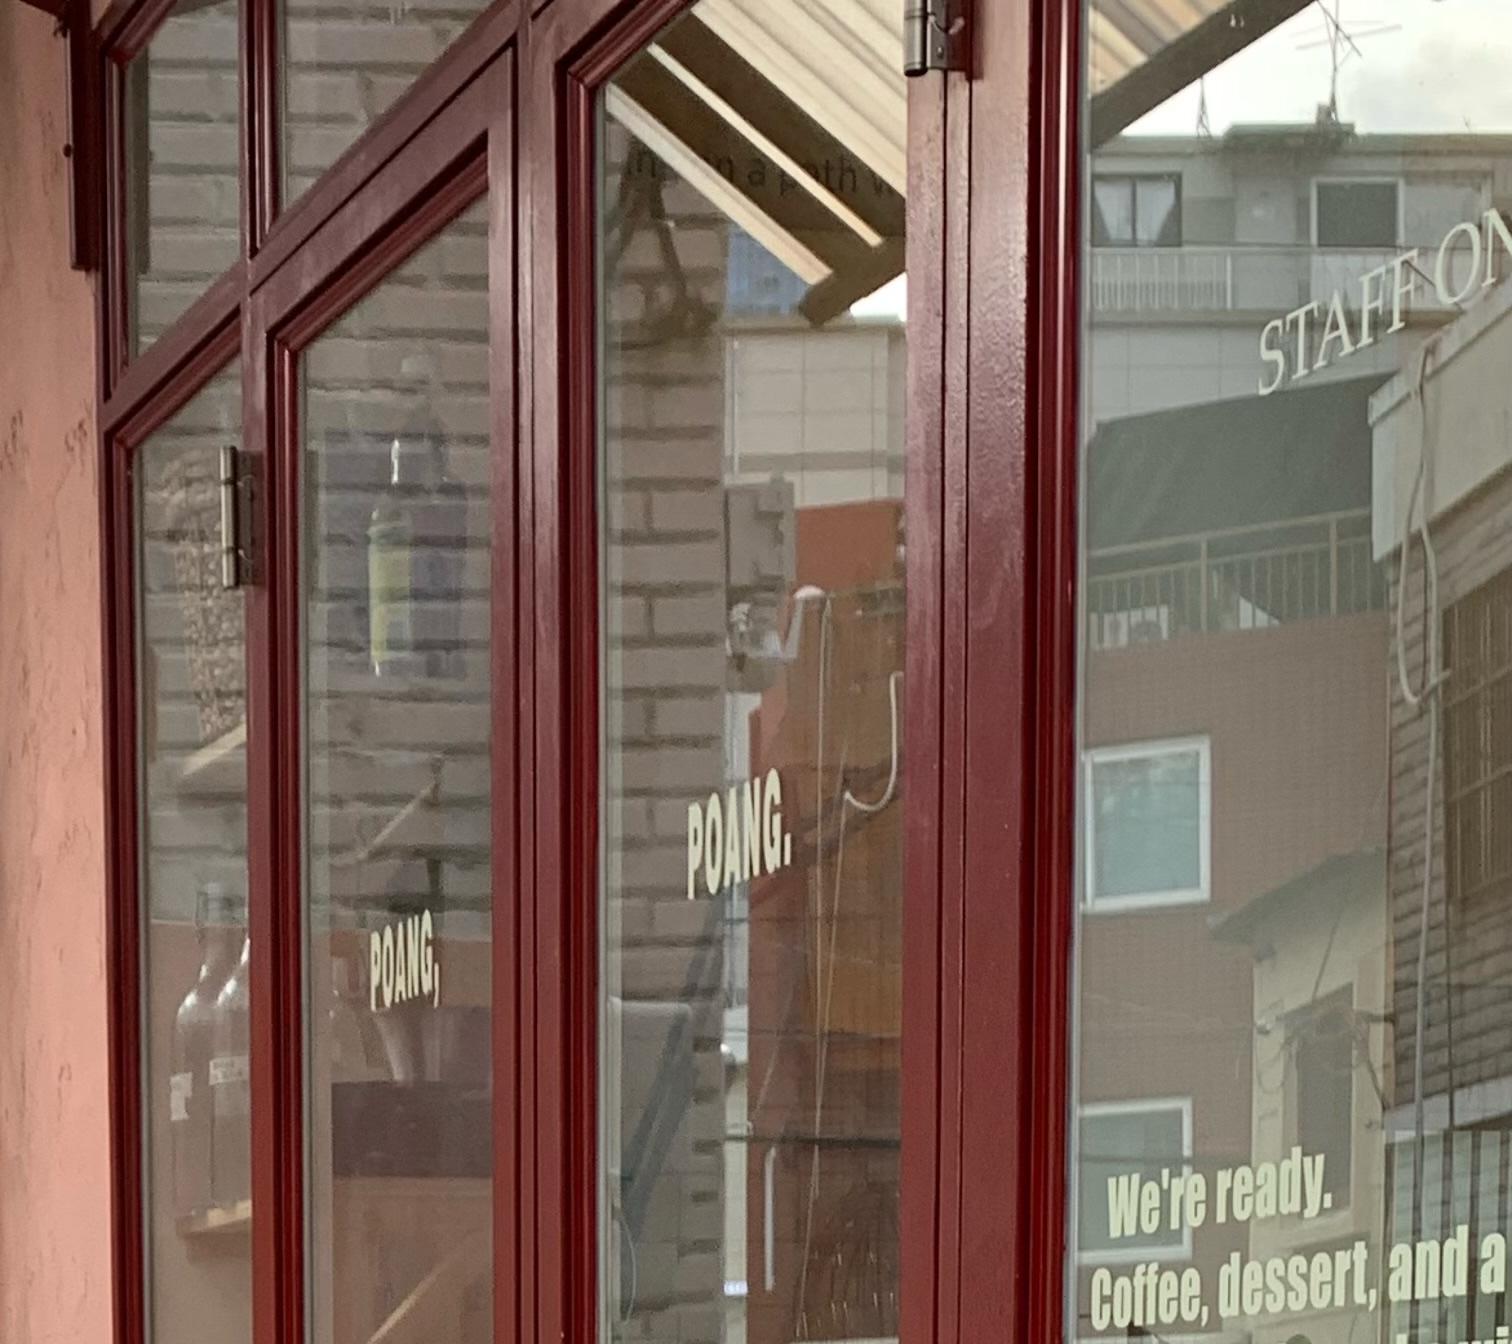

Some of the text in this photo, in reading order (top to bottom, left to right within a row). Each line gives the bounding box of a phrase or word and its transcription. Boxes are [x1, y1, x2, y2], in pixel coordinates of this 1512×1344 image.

[1258, 248, 1419, 396] STAFF
[1107, 1146, 1332, 1239] We're ready.
[1091, 1225, 1506, 1331] Coffee, dessert, and a
